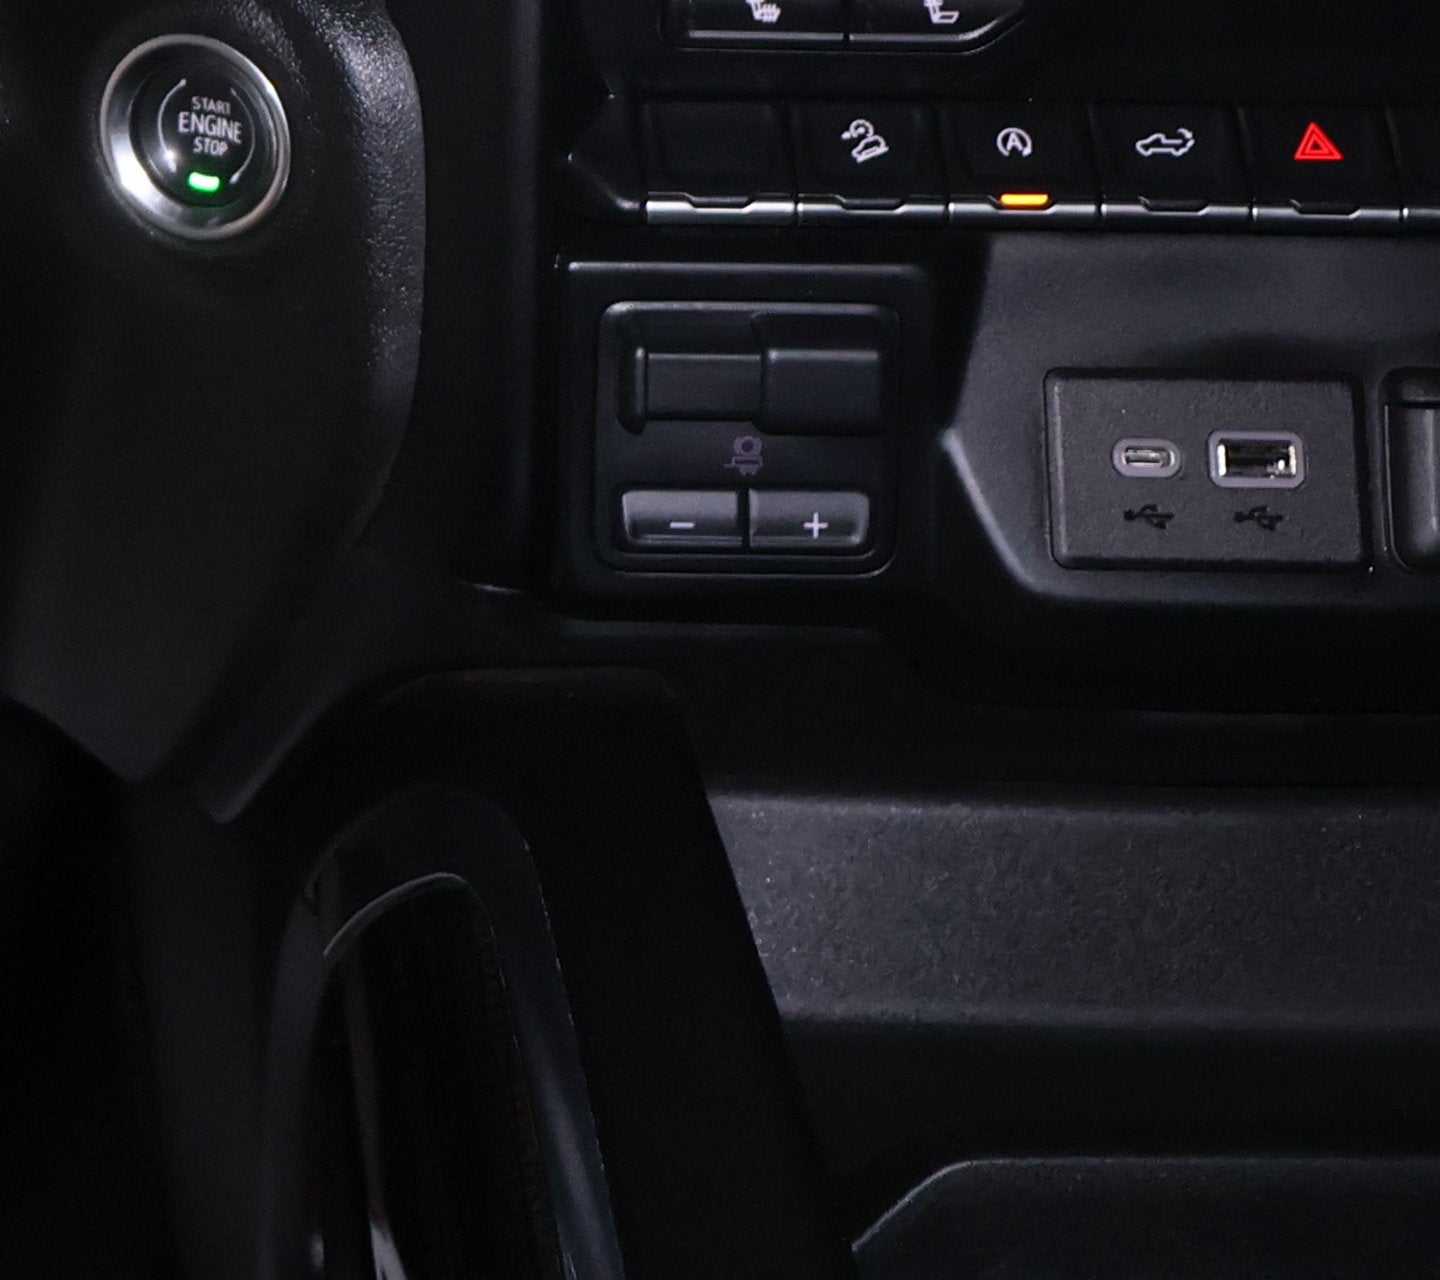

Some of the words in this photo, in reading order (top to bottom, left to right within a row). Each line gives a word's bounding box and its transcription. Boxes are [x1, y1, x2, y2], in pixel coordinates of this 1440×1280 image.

[191, 96, 231, 116] START
[178, 111, 242, 145] ENGINE
[193, 137, 229, 157] STOP
